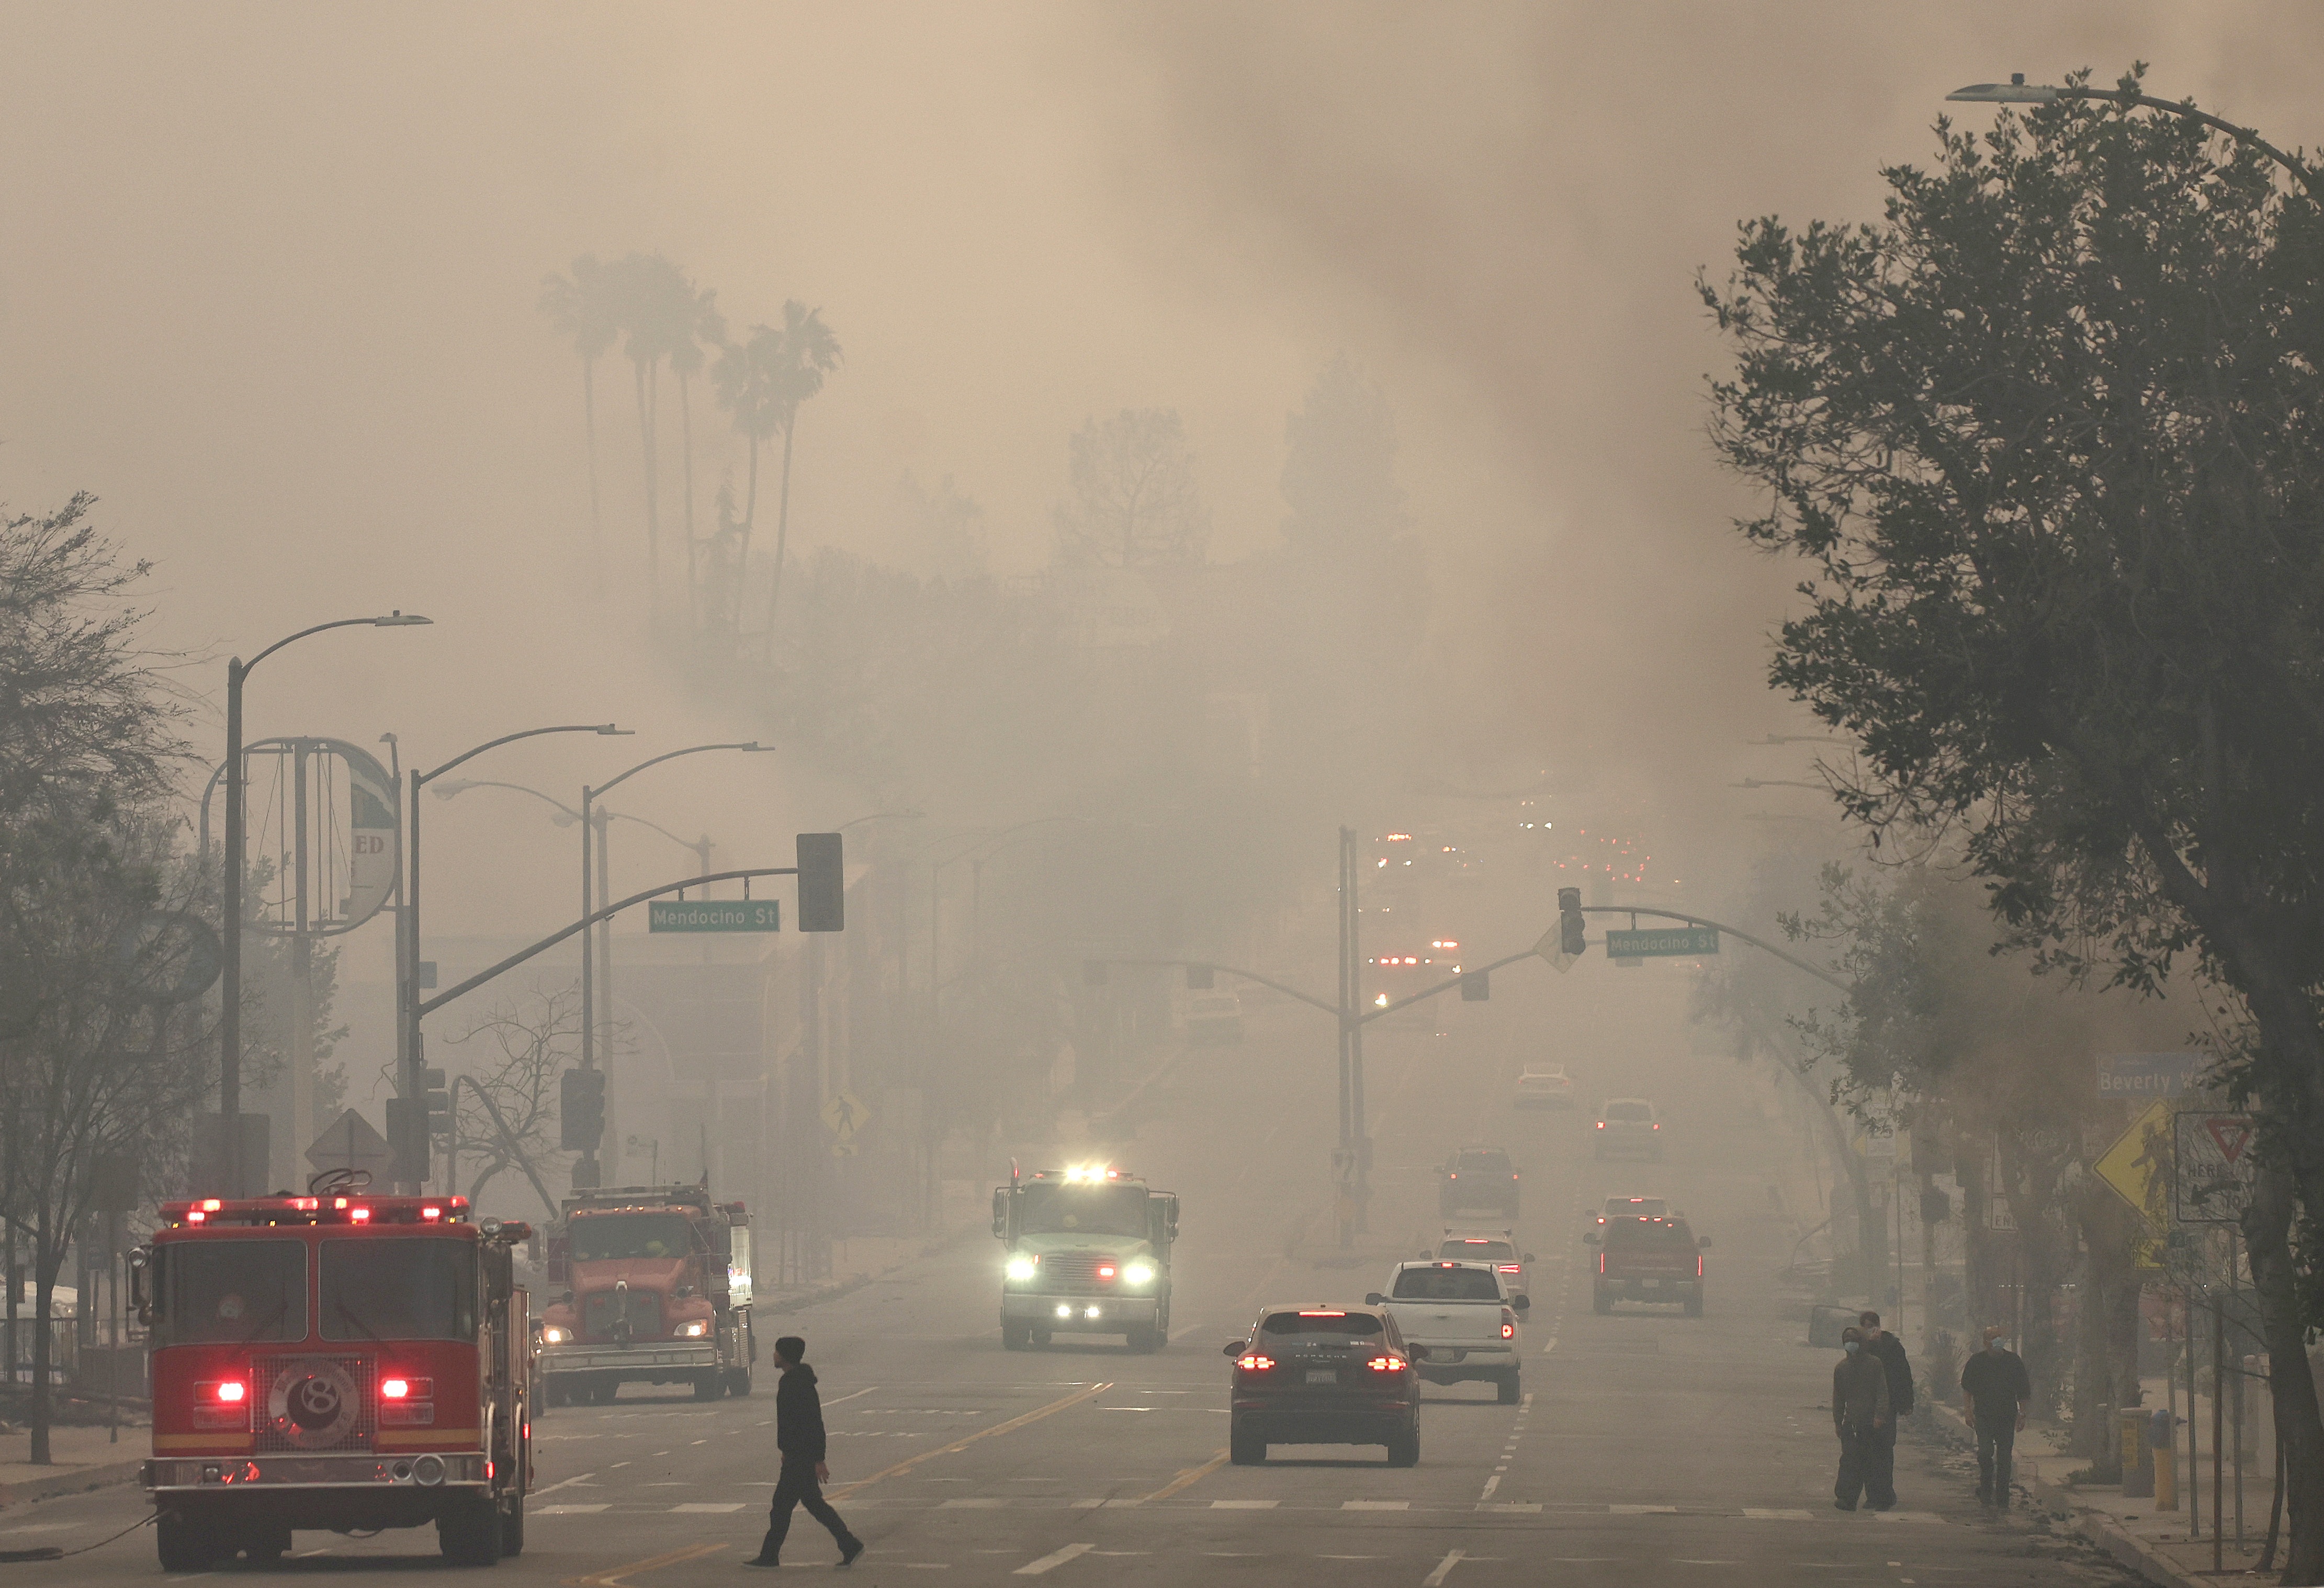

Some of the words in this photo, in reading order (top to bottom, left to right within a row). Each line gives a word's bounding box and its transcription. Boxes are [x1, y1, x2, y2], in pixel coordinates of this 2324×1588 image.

[355, 835, 385, 854] ED
[654, 909, 745, 925] Mendocino
[755, 908, 774, 924] St
[1611, 936, 1689, 951] Mendocino
[1698, 933, 1716, 948] St
[2100, 1072, 2171, 1093] Beverly
[1995, 1214, 2013, 1226] EN
[303, 1377, 339, 1414] 8
